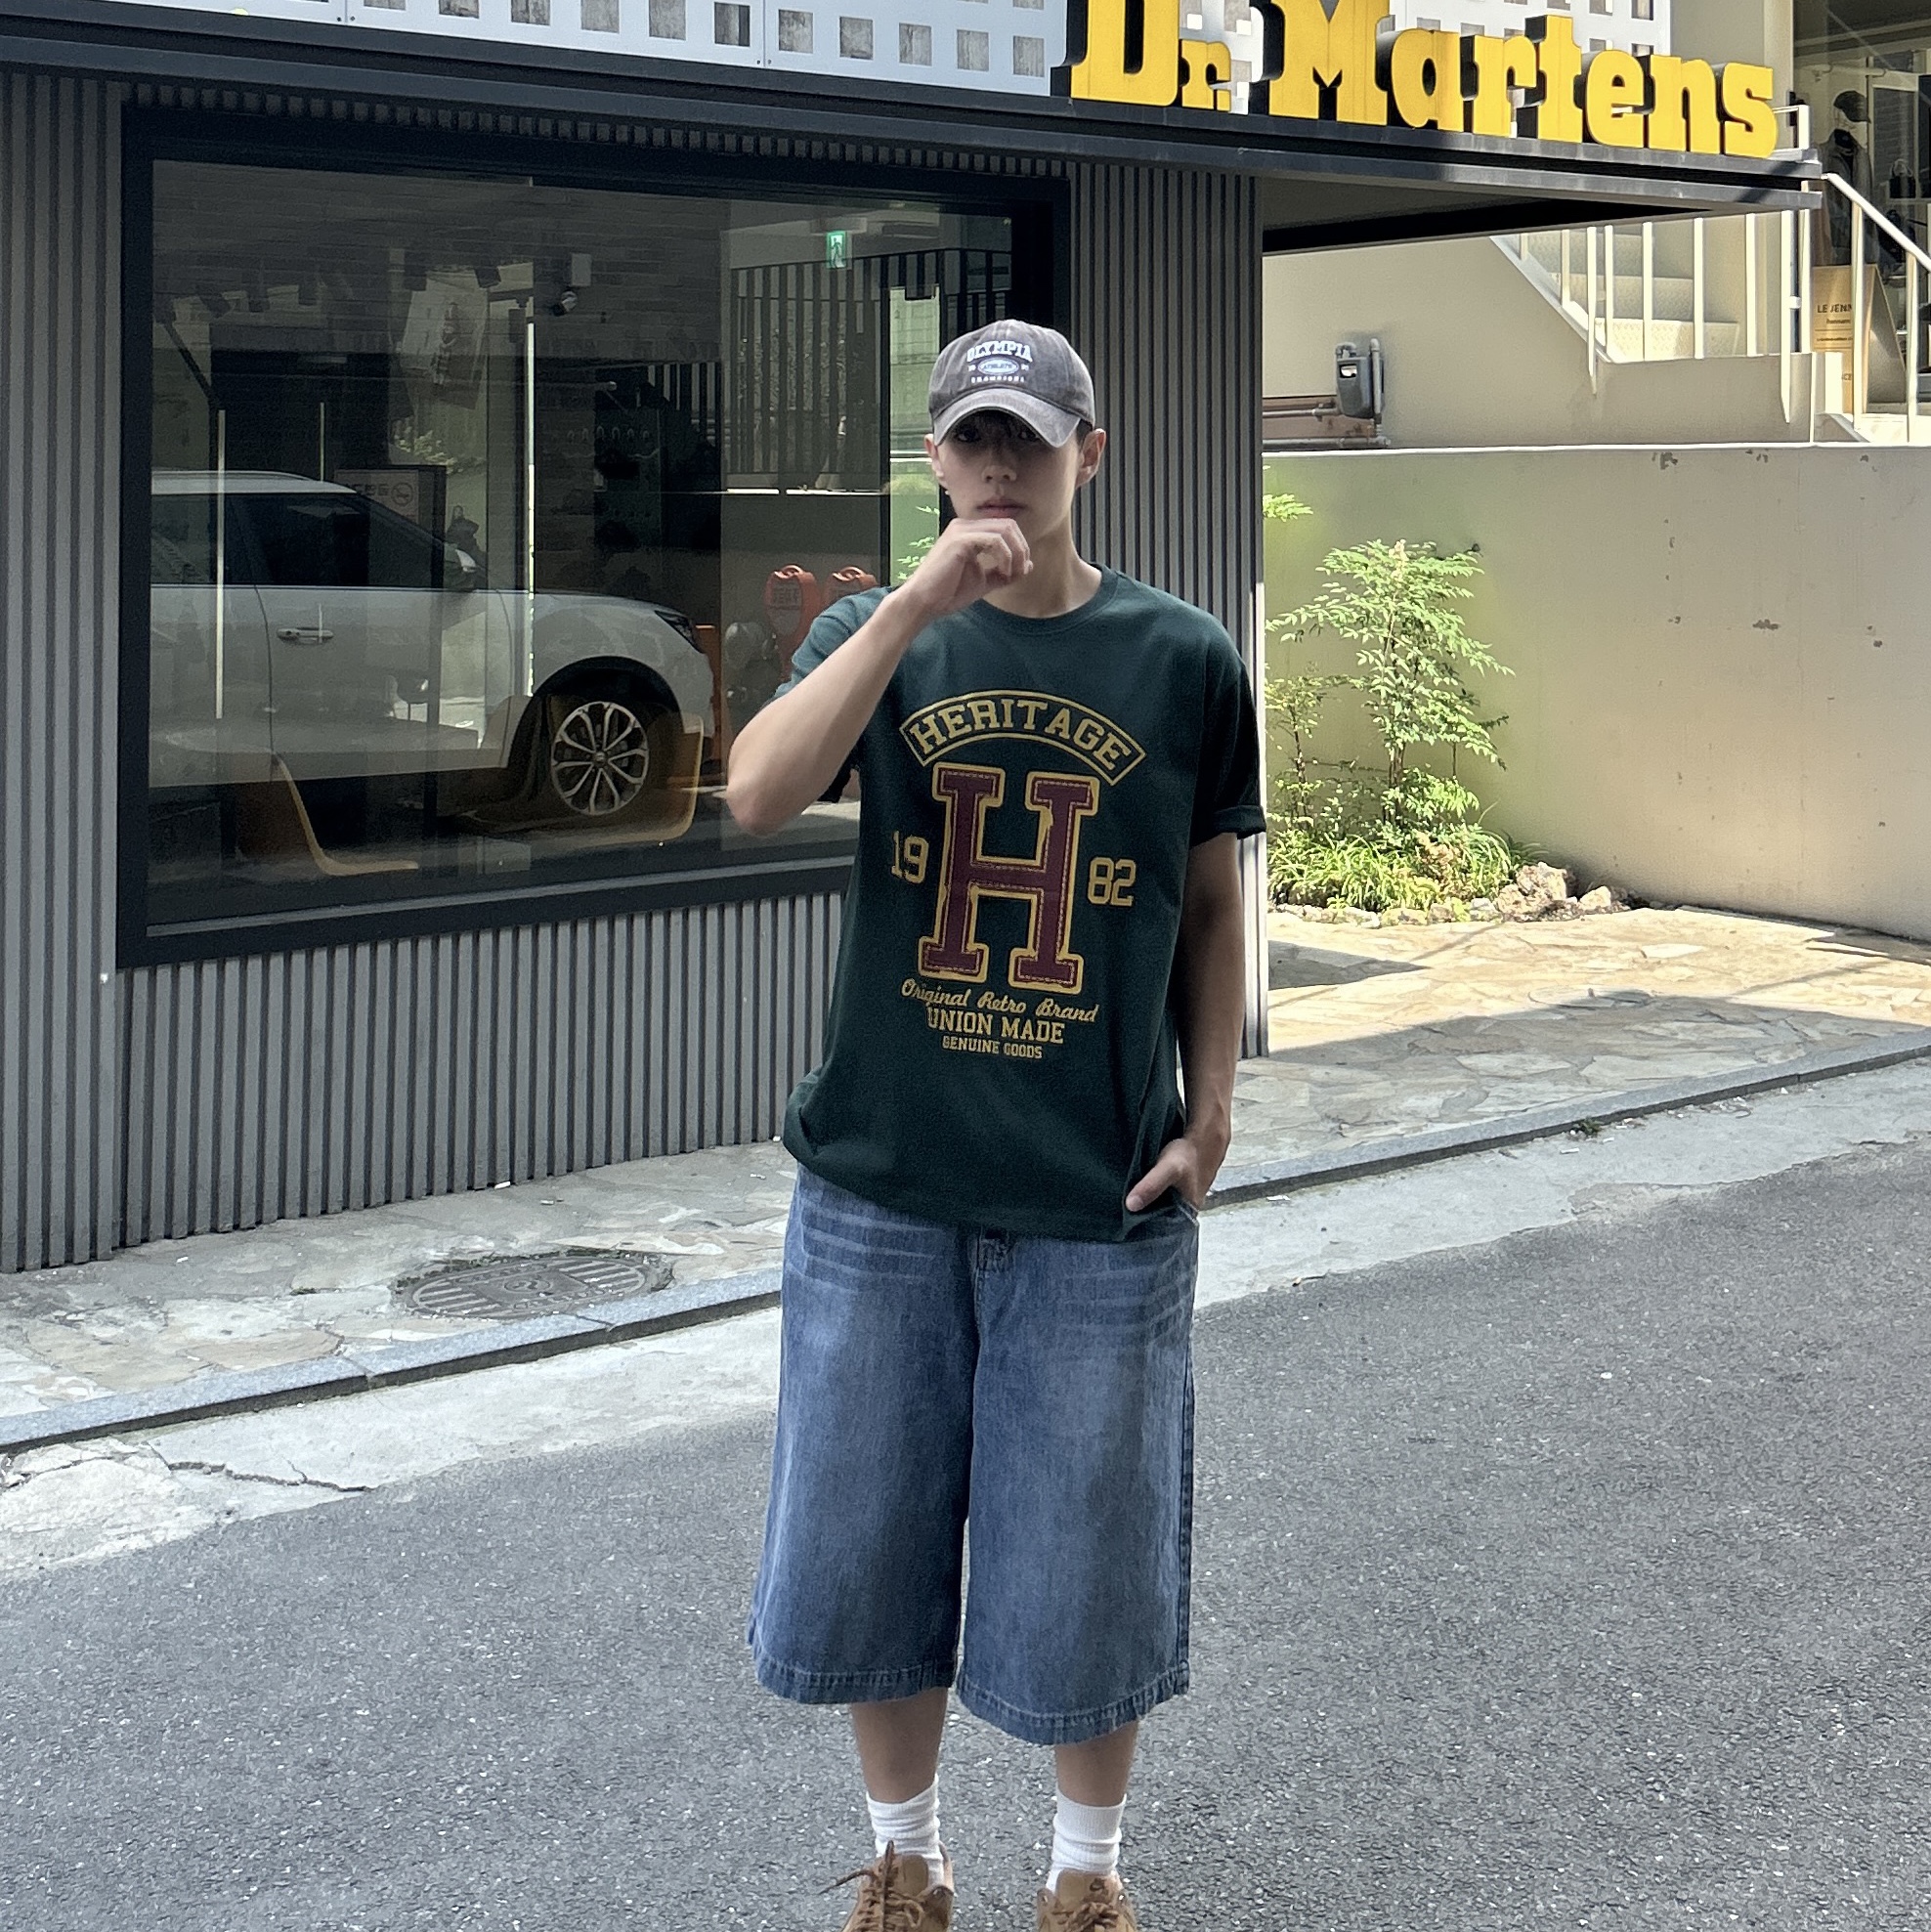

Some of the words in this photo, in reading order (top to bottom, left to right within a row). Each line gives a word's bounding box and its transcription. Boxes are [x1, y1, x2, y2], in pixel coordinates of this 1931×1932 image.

[1268, 0, 1778, 159] Martens
[1817, 304, 1827, 313] LE
[966, 340, 1034, 363] OLYMPIA
[910, 698, 1132, 771] HERITAGE
[890, 831, 929, 883] 19
[1087, 857, 1137, 907] 82
[919, 761, 1099, 995] H
[901, 978, 971, 1008] Original
[977, 991, 1027, 1014] Retro
[1035, 998, 1099, 1023] Brand
[926, 1007, 994, 1036] UNION
[1001, 1016, 1065, 1045] MADE
[942, 1035, 1001, 1054] GENUINE
[1004, 1043, 1043, 1059] GOODS
